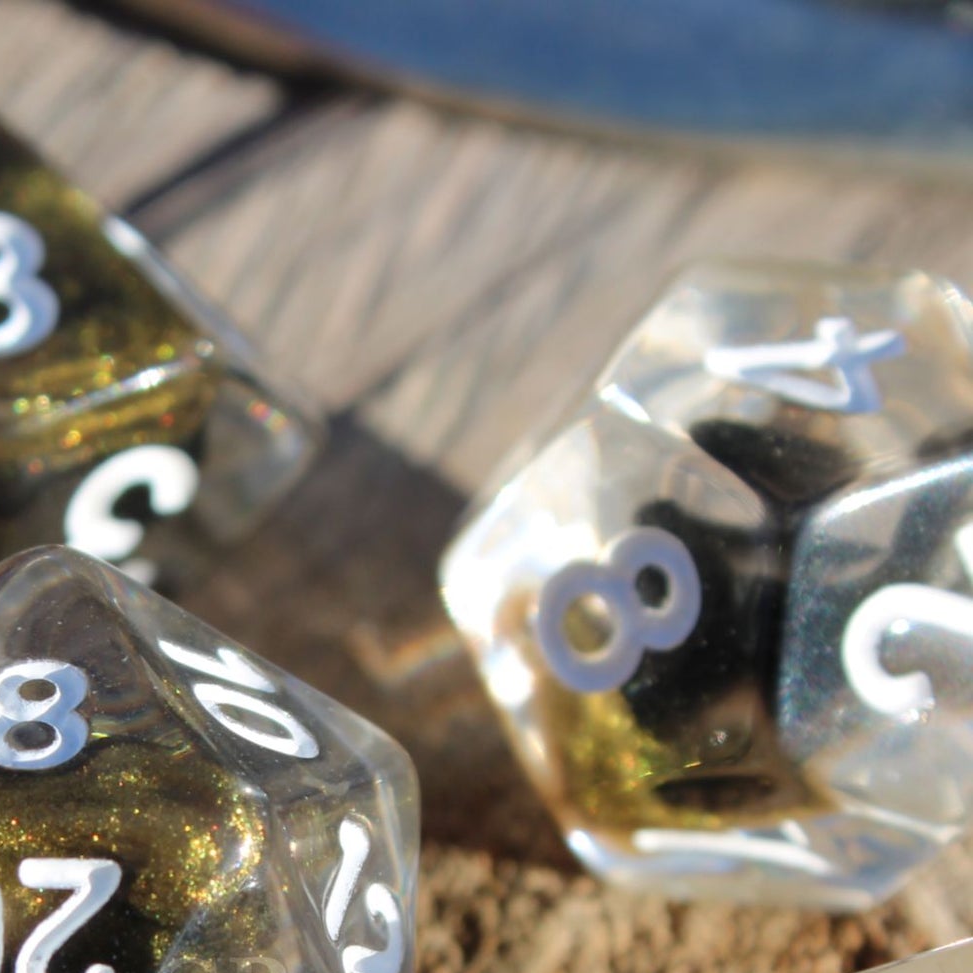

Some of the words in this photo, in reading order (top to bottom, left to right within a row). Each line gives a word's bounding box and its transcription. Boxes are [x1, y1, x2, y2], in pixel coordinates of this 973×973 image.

[703, 317, 906, 414] 4
[537, 525, 702, 692] 8
[157, 638, 320, 759] 10
